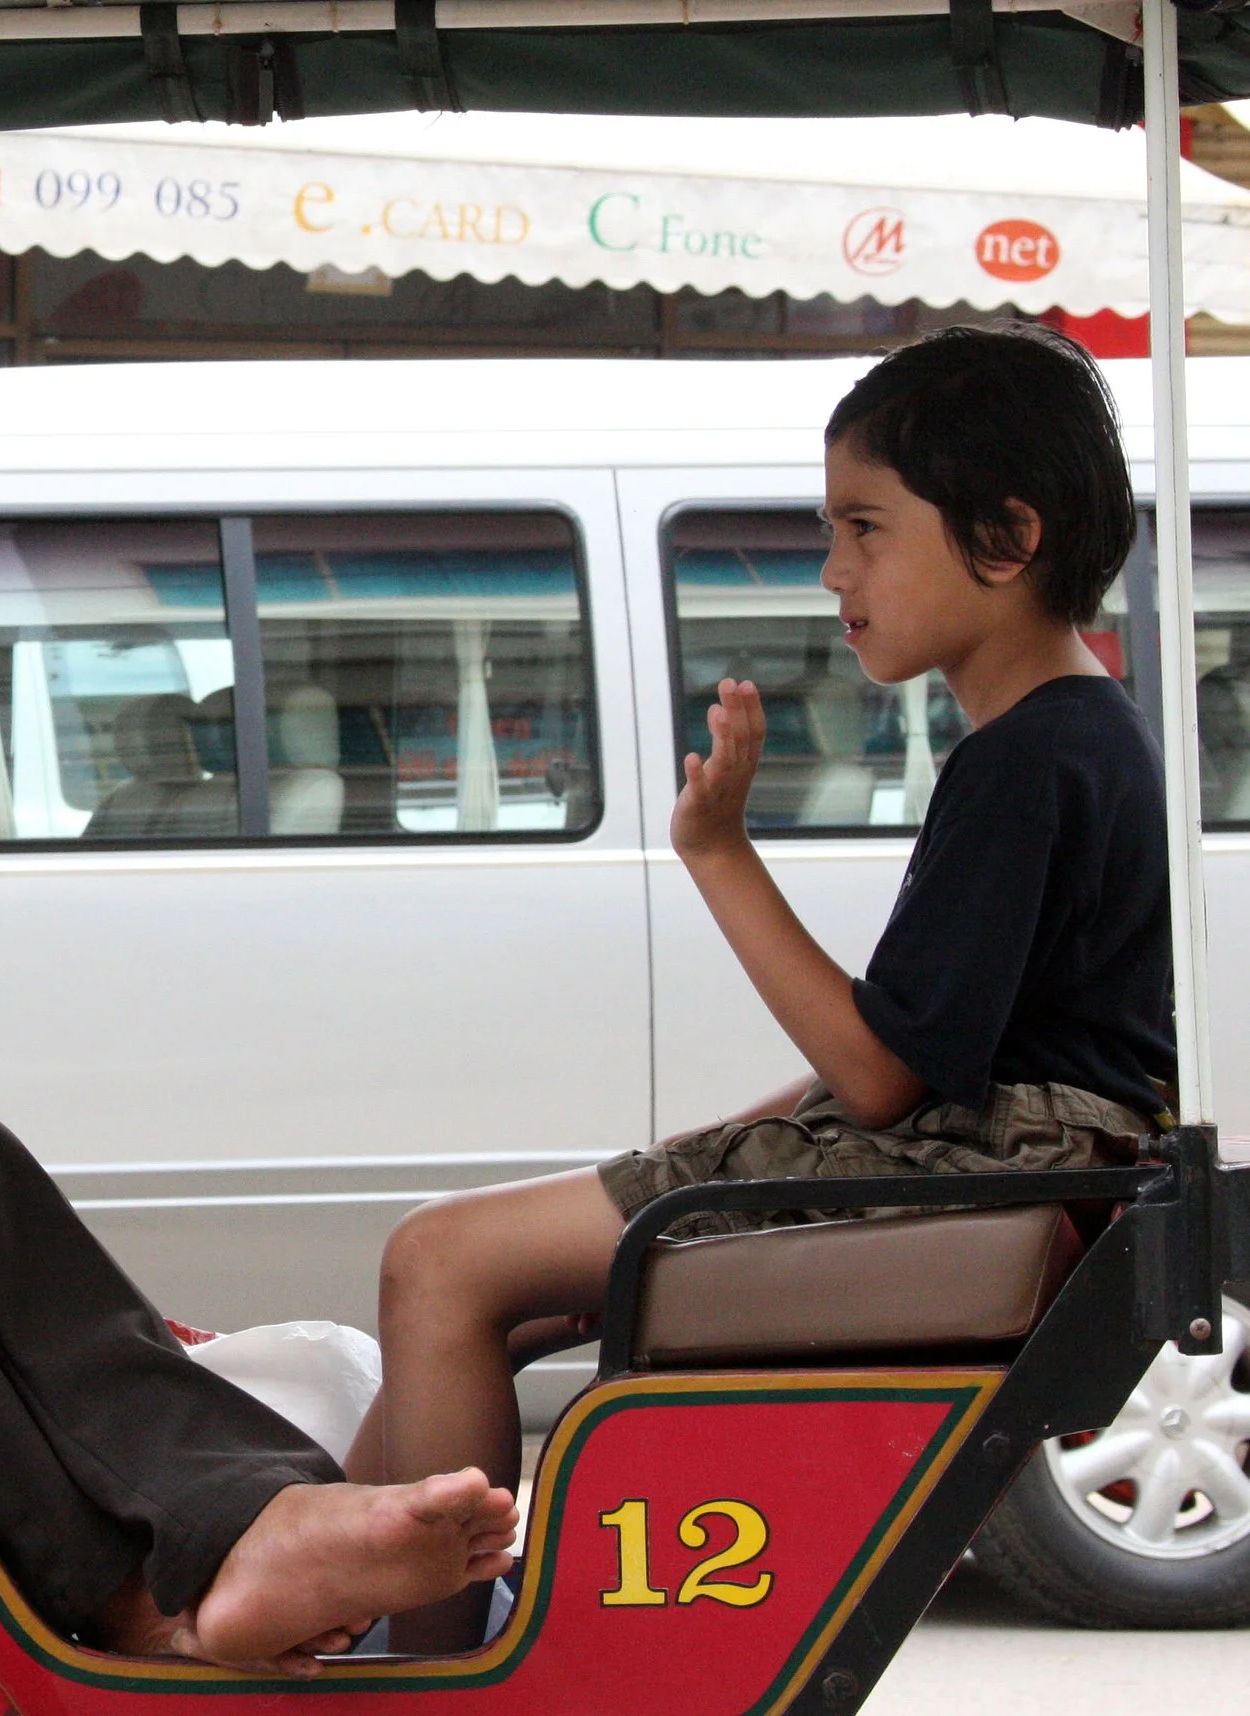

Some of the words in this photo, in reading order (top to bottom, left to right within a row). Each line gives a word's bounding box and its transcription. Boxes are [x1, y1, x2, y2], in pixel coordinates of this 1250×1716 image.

[35, 168, 122, 212] 099
[155, 176, 241, 221] 085
[660, 213, 764, 259] Fone
[981, 232, 1053, 269] net
[599, 1498, 774, 1608] 12
